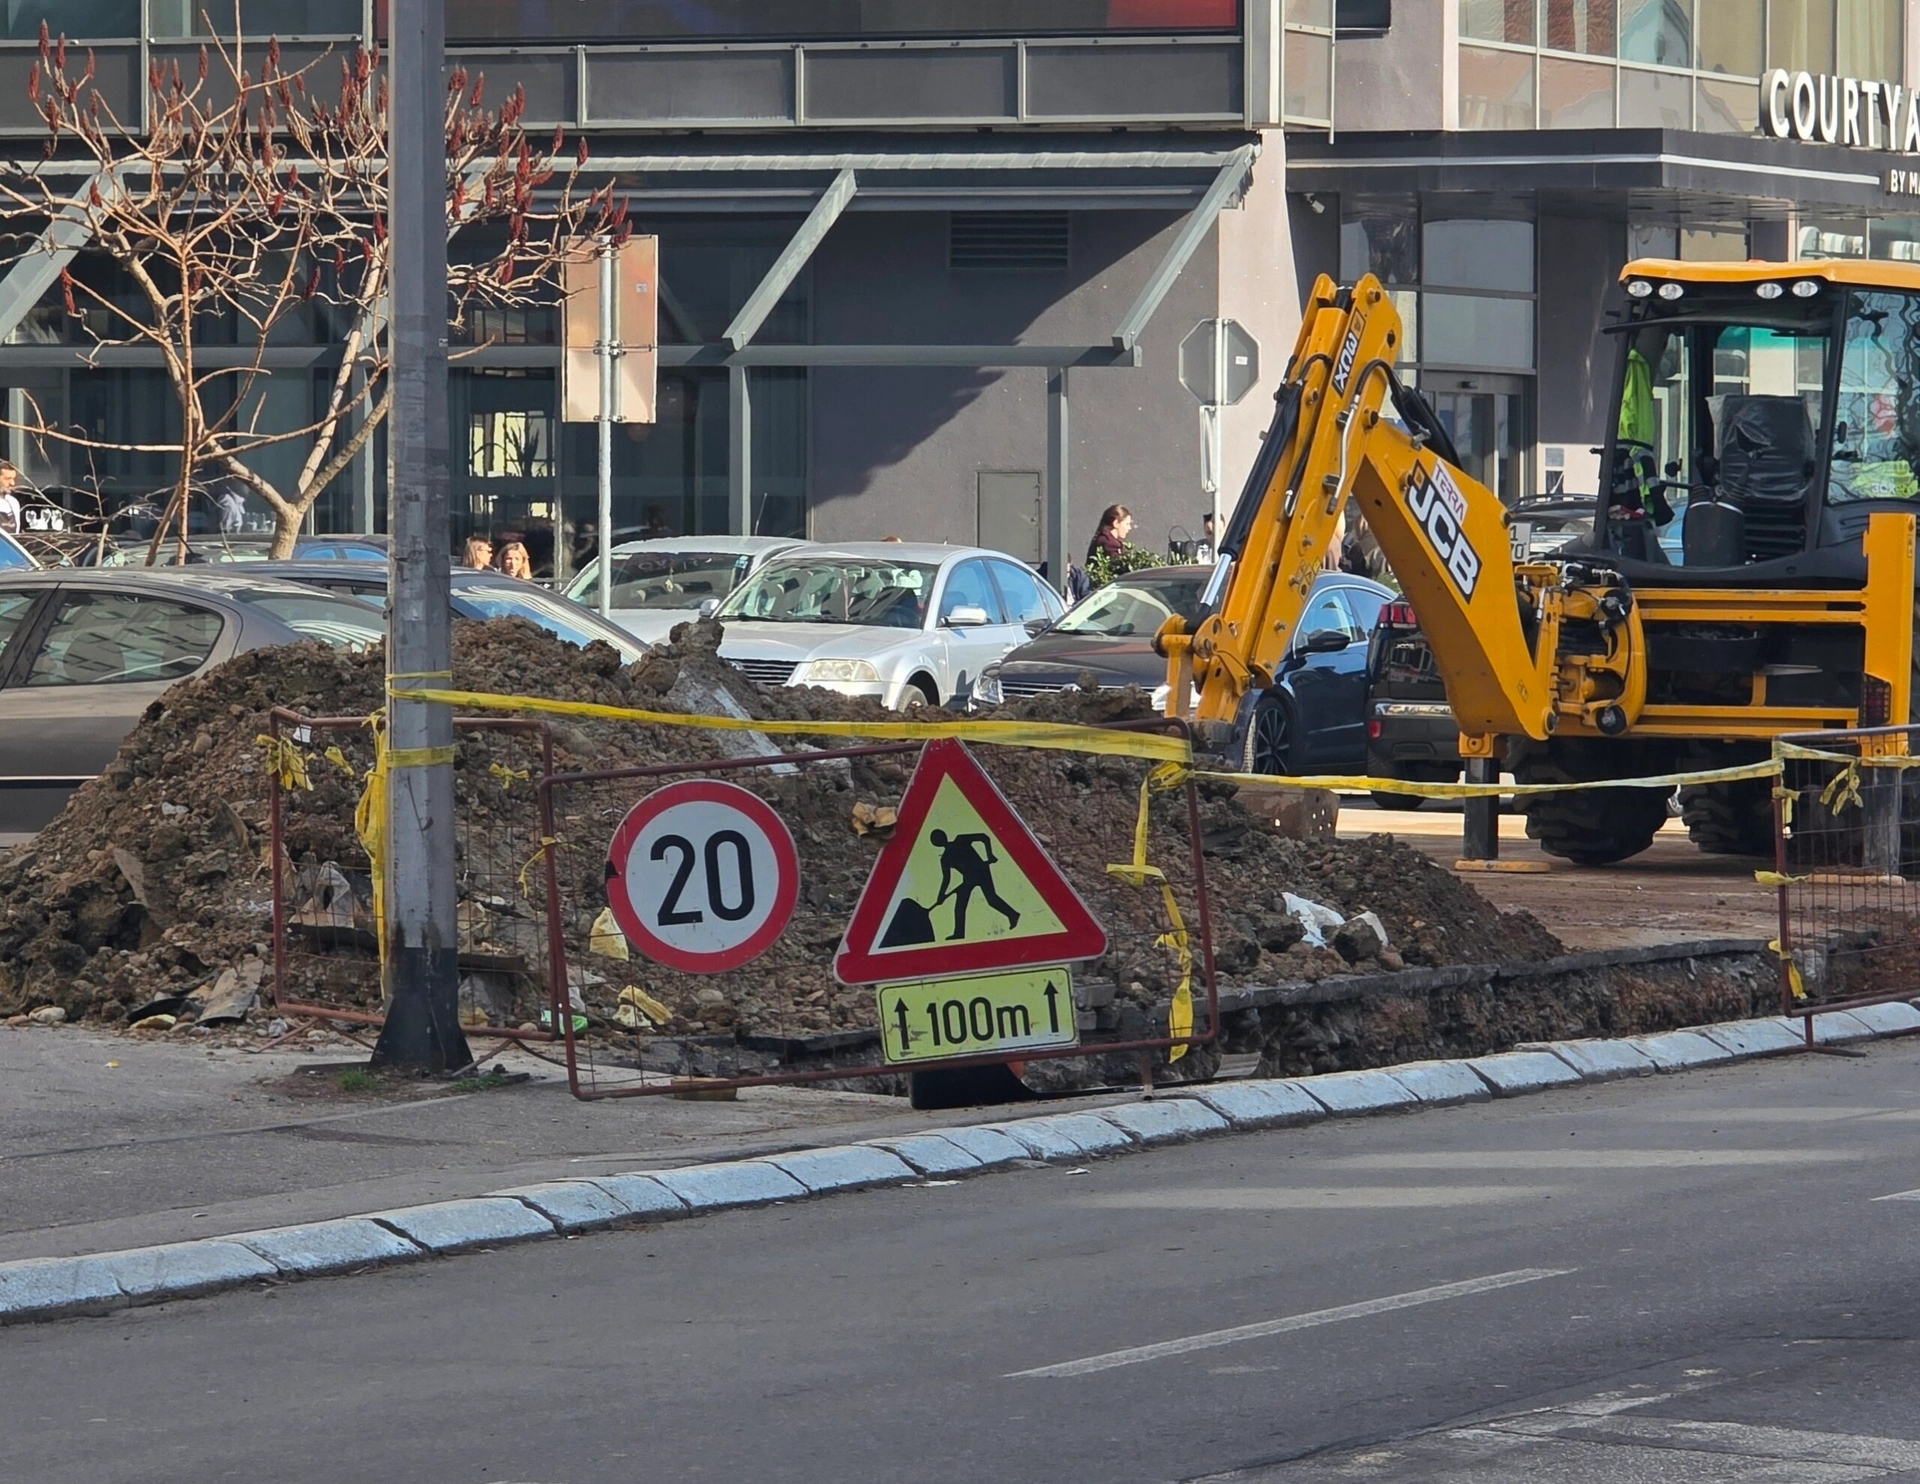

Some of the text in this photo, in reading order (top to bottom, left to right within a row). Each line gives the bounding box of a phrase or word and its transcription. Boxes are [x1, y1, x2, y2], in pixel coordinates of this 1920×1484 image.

[1768, 68, 1920, 152] COURTYA
[1890, 168, 1920, 195] BY M
[1334, 331, 1359, 390] 3CX
[1435, 462, 1465, 522] TERRA
[1408, 483, 1479, 596] JCB
[650, 829, 755, 927] 20
[926, 996, 1031, 1047] 100m
